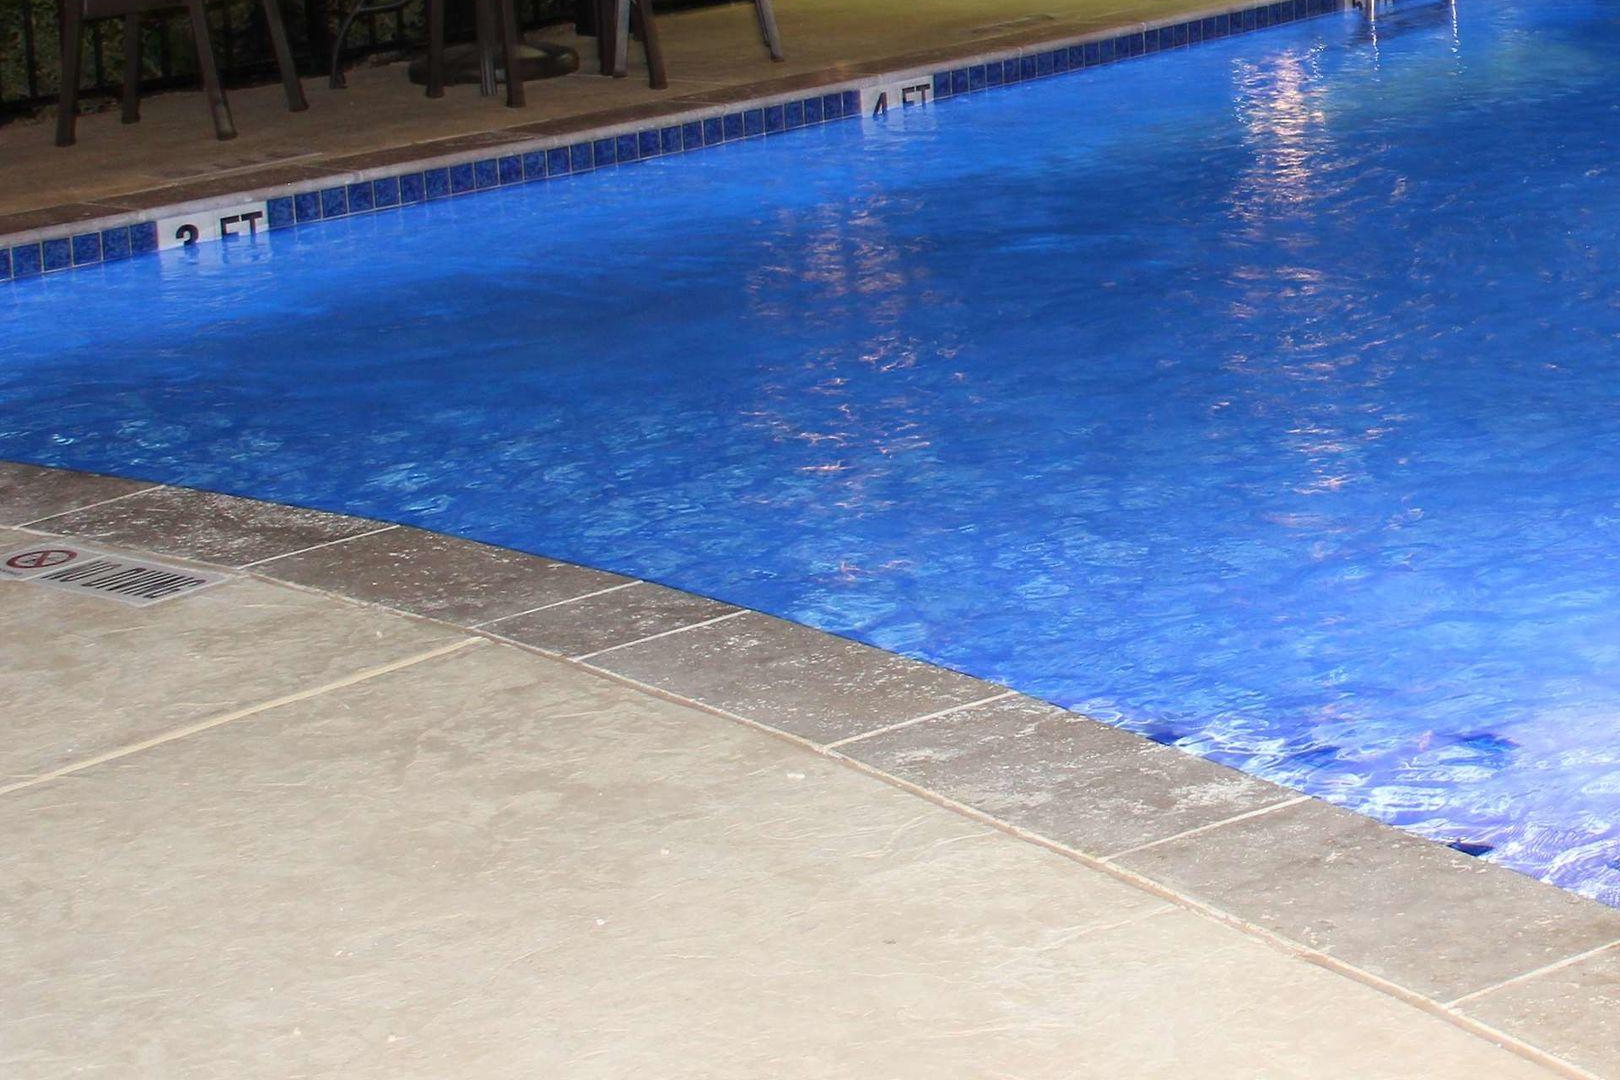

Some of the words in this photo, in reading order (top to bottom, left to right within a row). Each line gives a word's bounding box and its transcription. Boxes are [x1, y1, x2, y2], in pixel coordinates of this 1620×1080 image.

[901, 83, 931, 108] FT
[219, 210, 263, 238] FT
[40, 560, 122, 583] NO
[81, 567, 207, 600] DIVING
